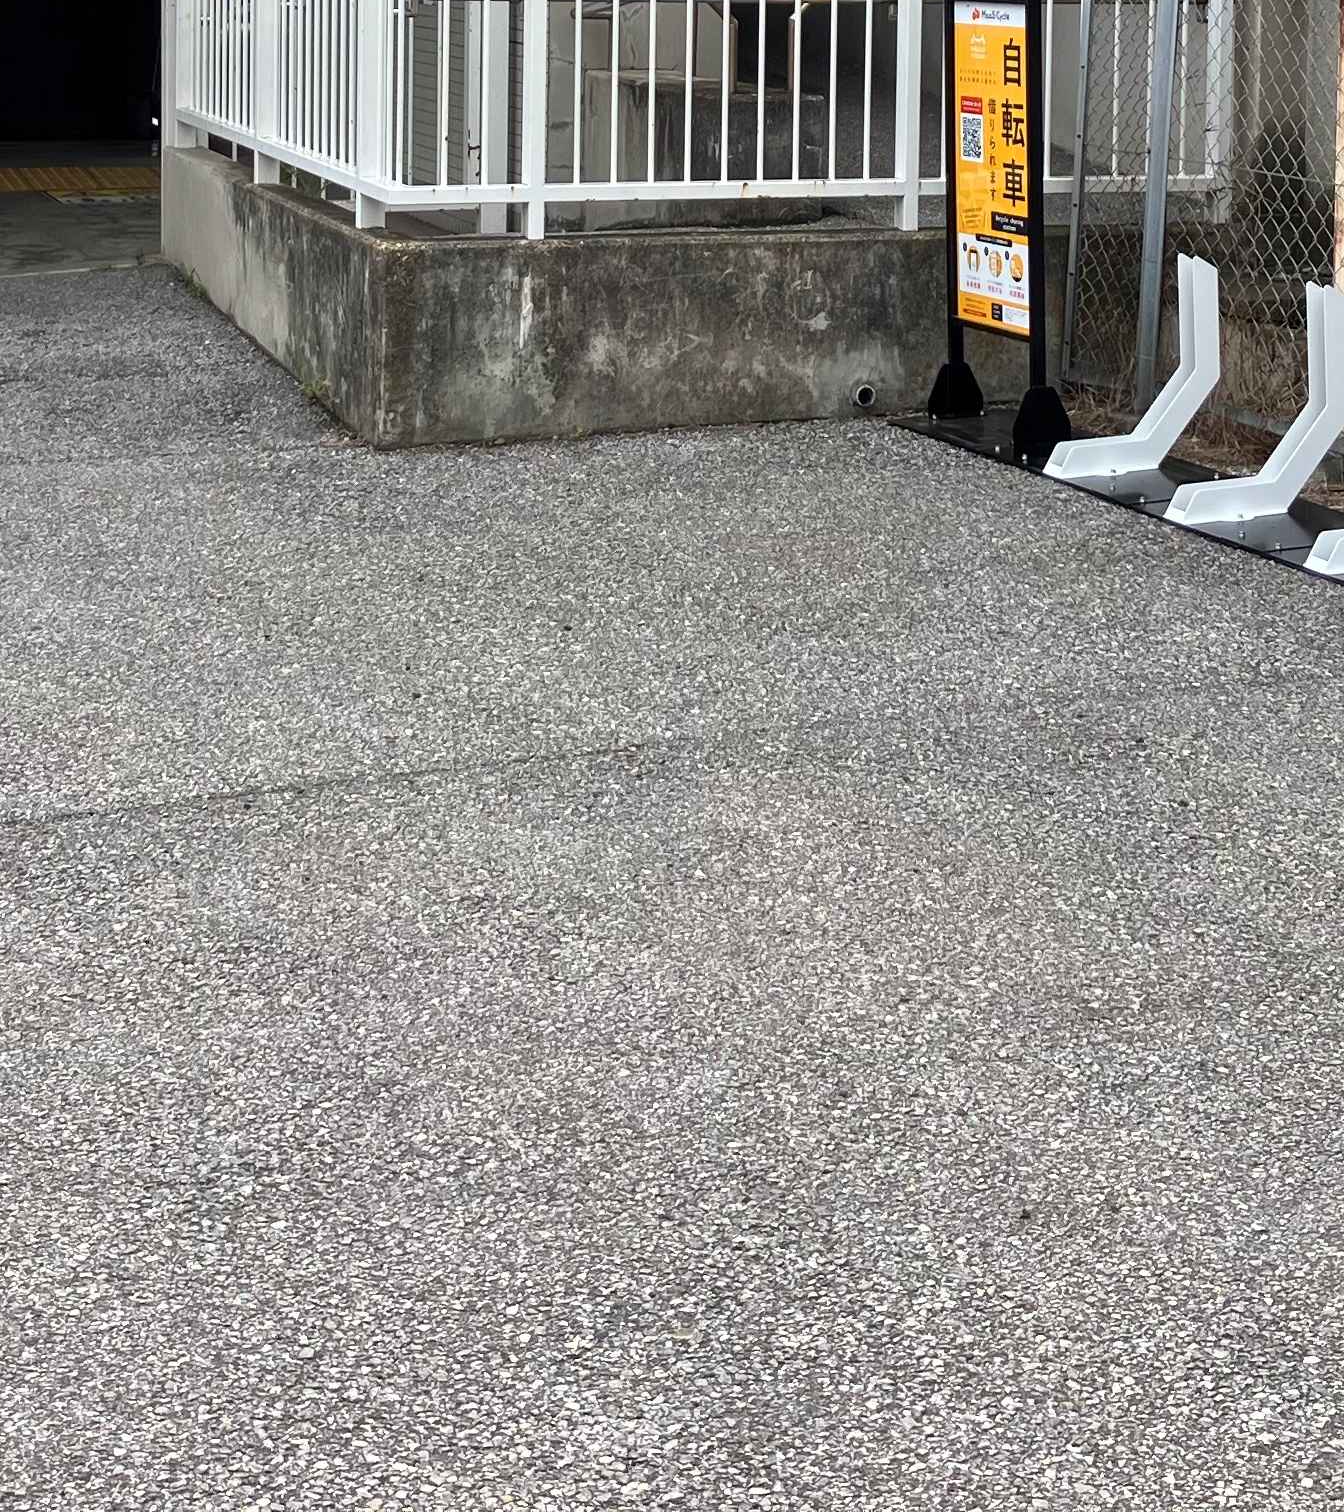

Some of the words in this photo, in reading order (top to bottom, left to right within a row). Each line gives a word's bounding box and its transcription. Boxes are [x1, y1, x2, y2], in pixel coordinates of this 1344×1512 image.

[987, 97, 997, 201] 借りられます
[1002, 37, 1026, 208] 自転車
